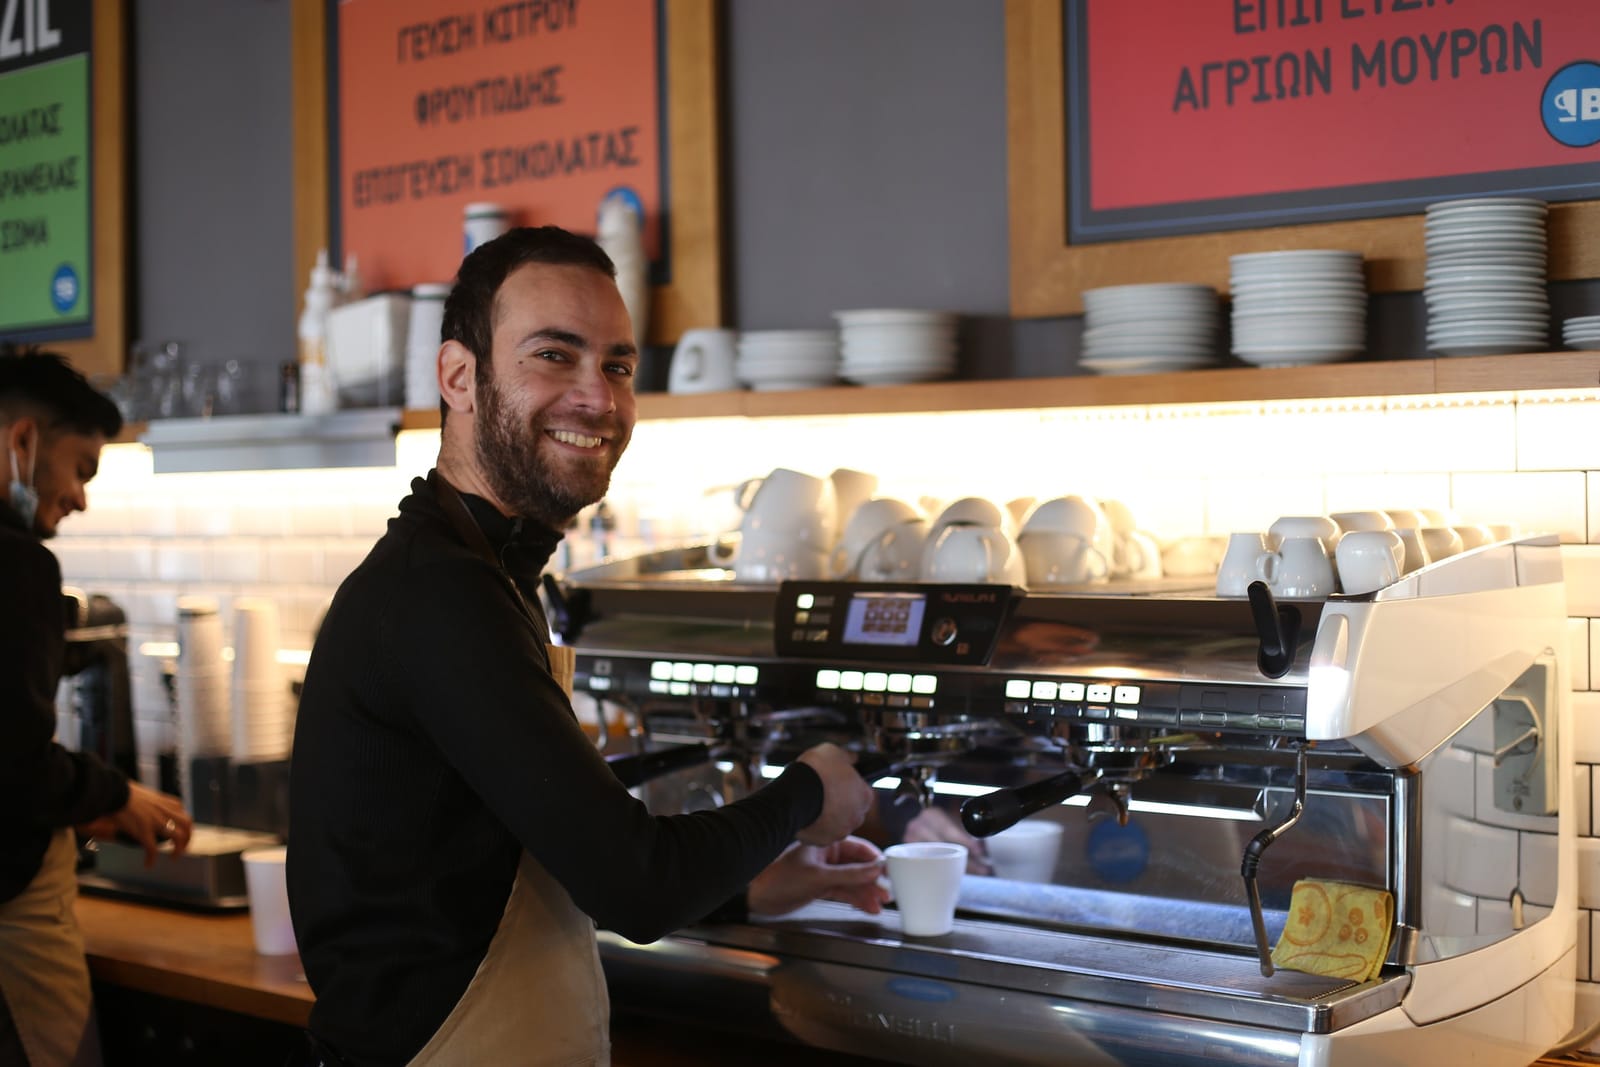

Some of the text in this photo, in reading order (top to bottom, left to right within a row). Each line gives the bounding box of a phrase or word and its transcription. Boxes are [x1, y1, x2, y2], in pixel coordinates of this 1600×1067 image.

[396, 0, 580, 64] ΓΕΥΣΗ ΚΙΤΡΟΥ
[414, 65, 565, 126] ΦΡΟΥΤΩΔΗΣ
[1172, 19, 1543, 113] ΑΓΡΙΩΝ ΜΟΥΡΩΝ
[480, 125, 641, 189] ΣΟΚΟΛΑΤΑΣ
